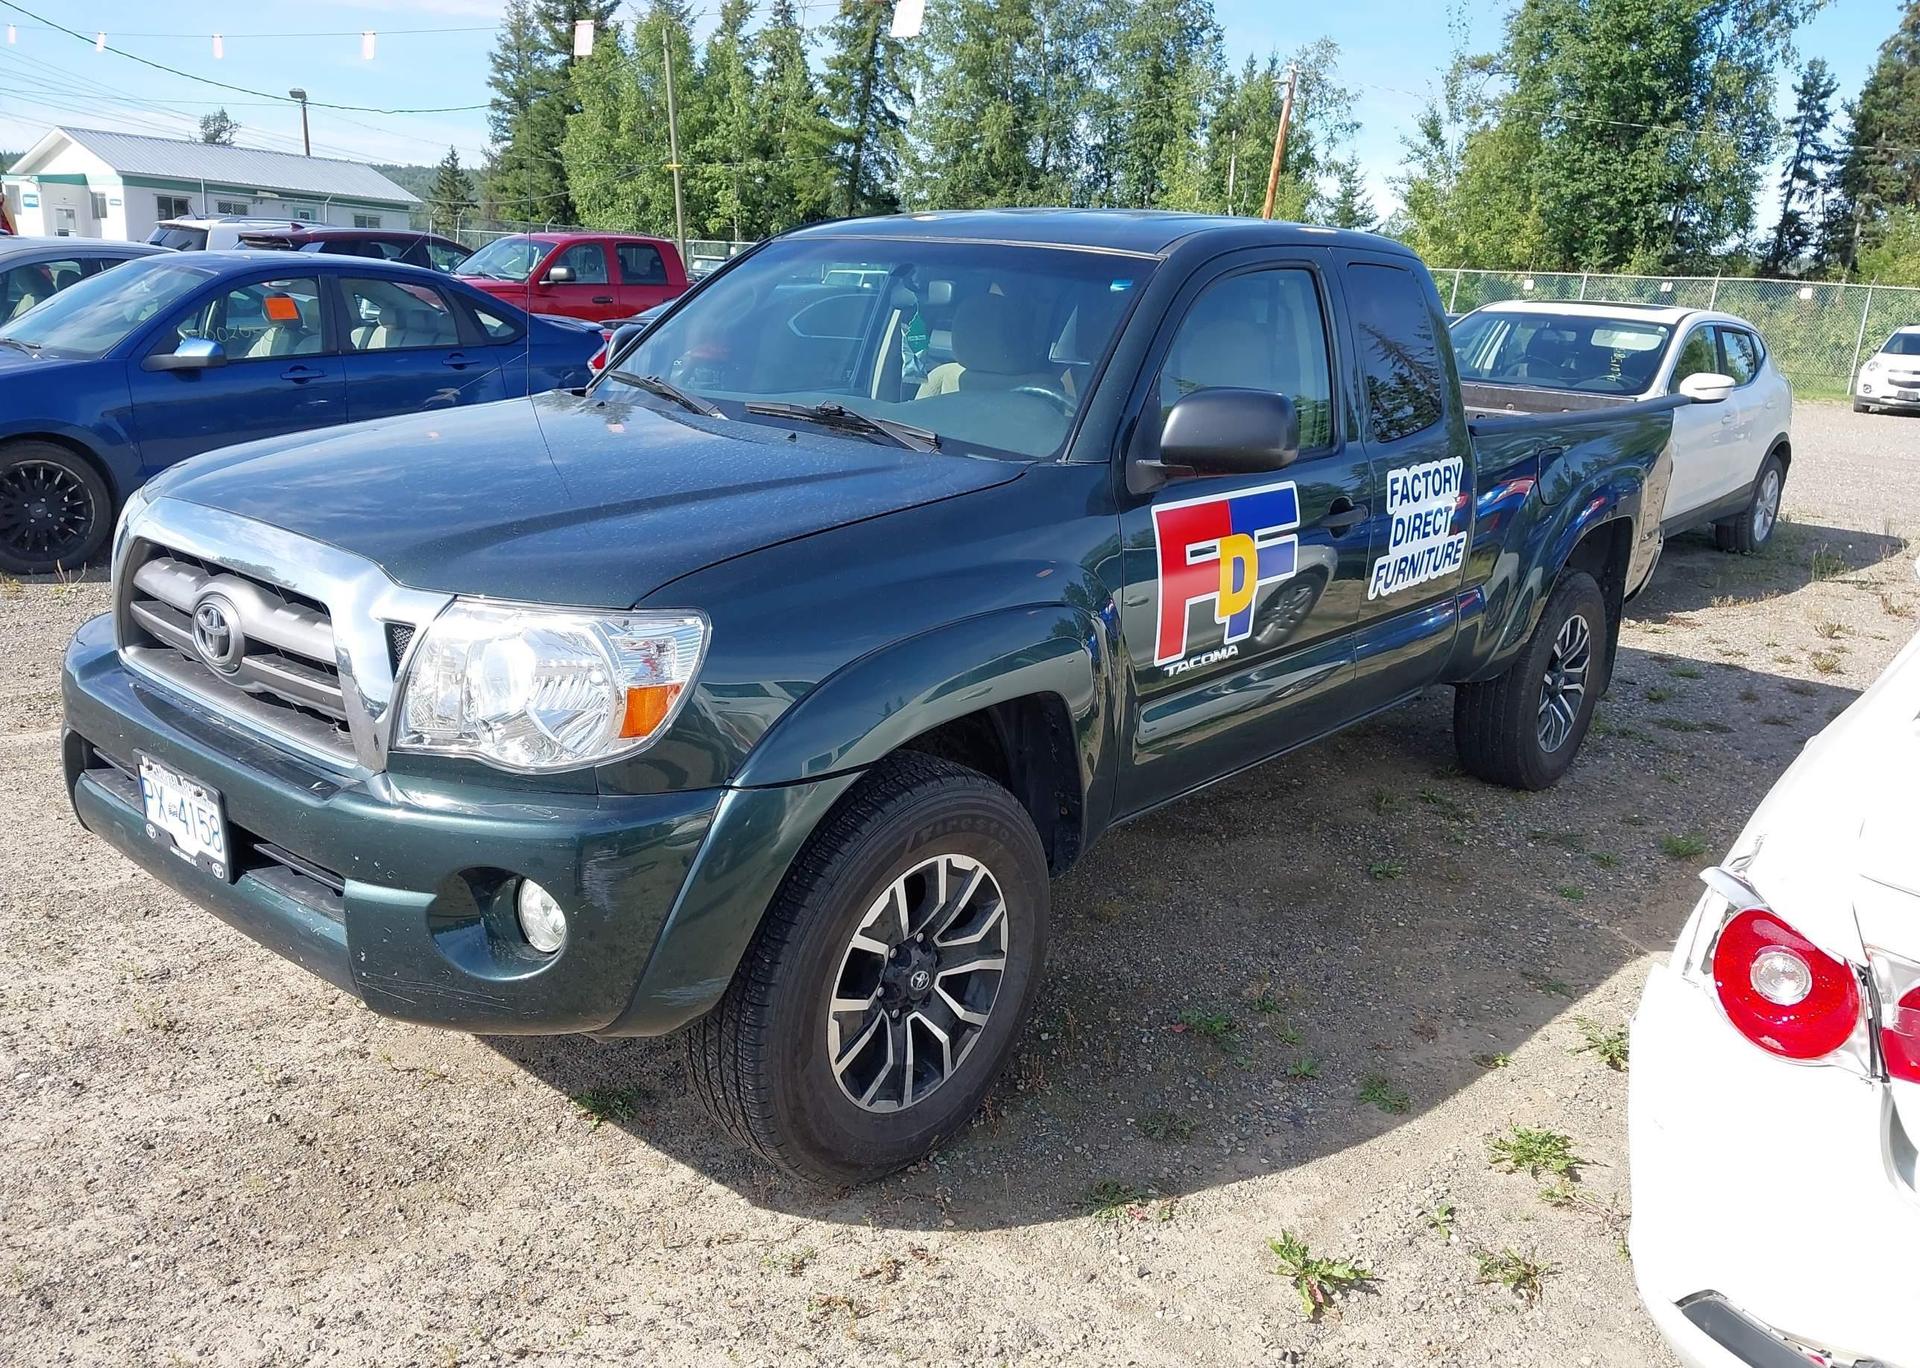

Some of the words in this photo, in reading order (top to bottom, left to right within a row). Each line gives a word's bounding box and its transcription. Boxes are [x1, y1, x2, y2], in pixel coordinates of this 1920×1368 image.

[1389, 463, 1463, 508] FACTORY
[1392, 506, 1453, 547] DIRECT
[1371, 539, 1465, 594] FURNITURE
[1163, 644, 1239, 677] TACOMA
[142, 777, 168, 823] PX
[178, 797, 222, 853] 4158
